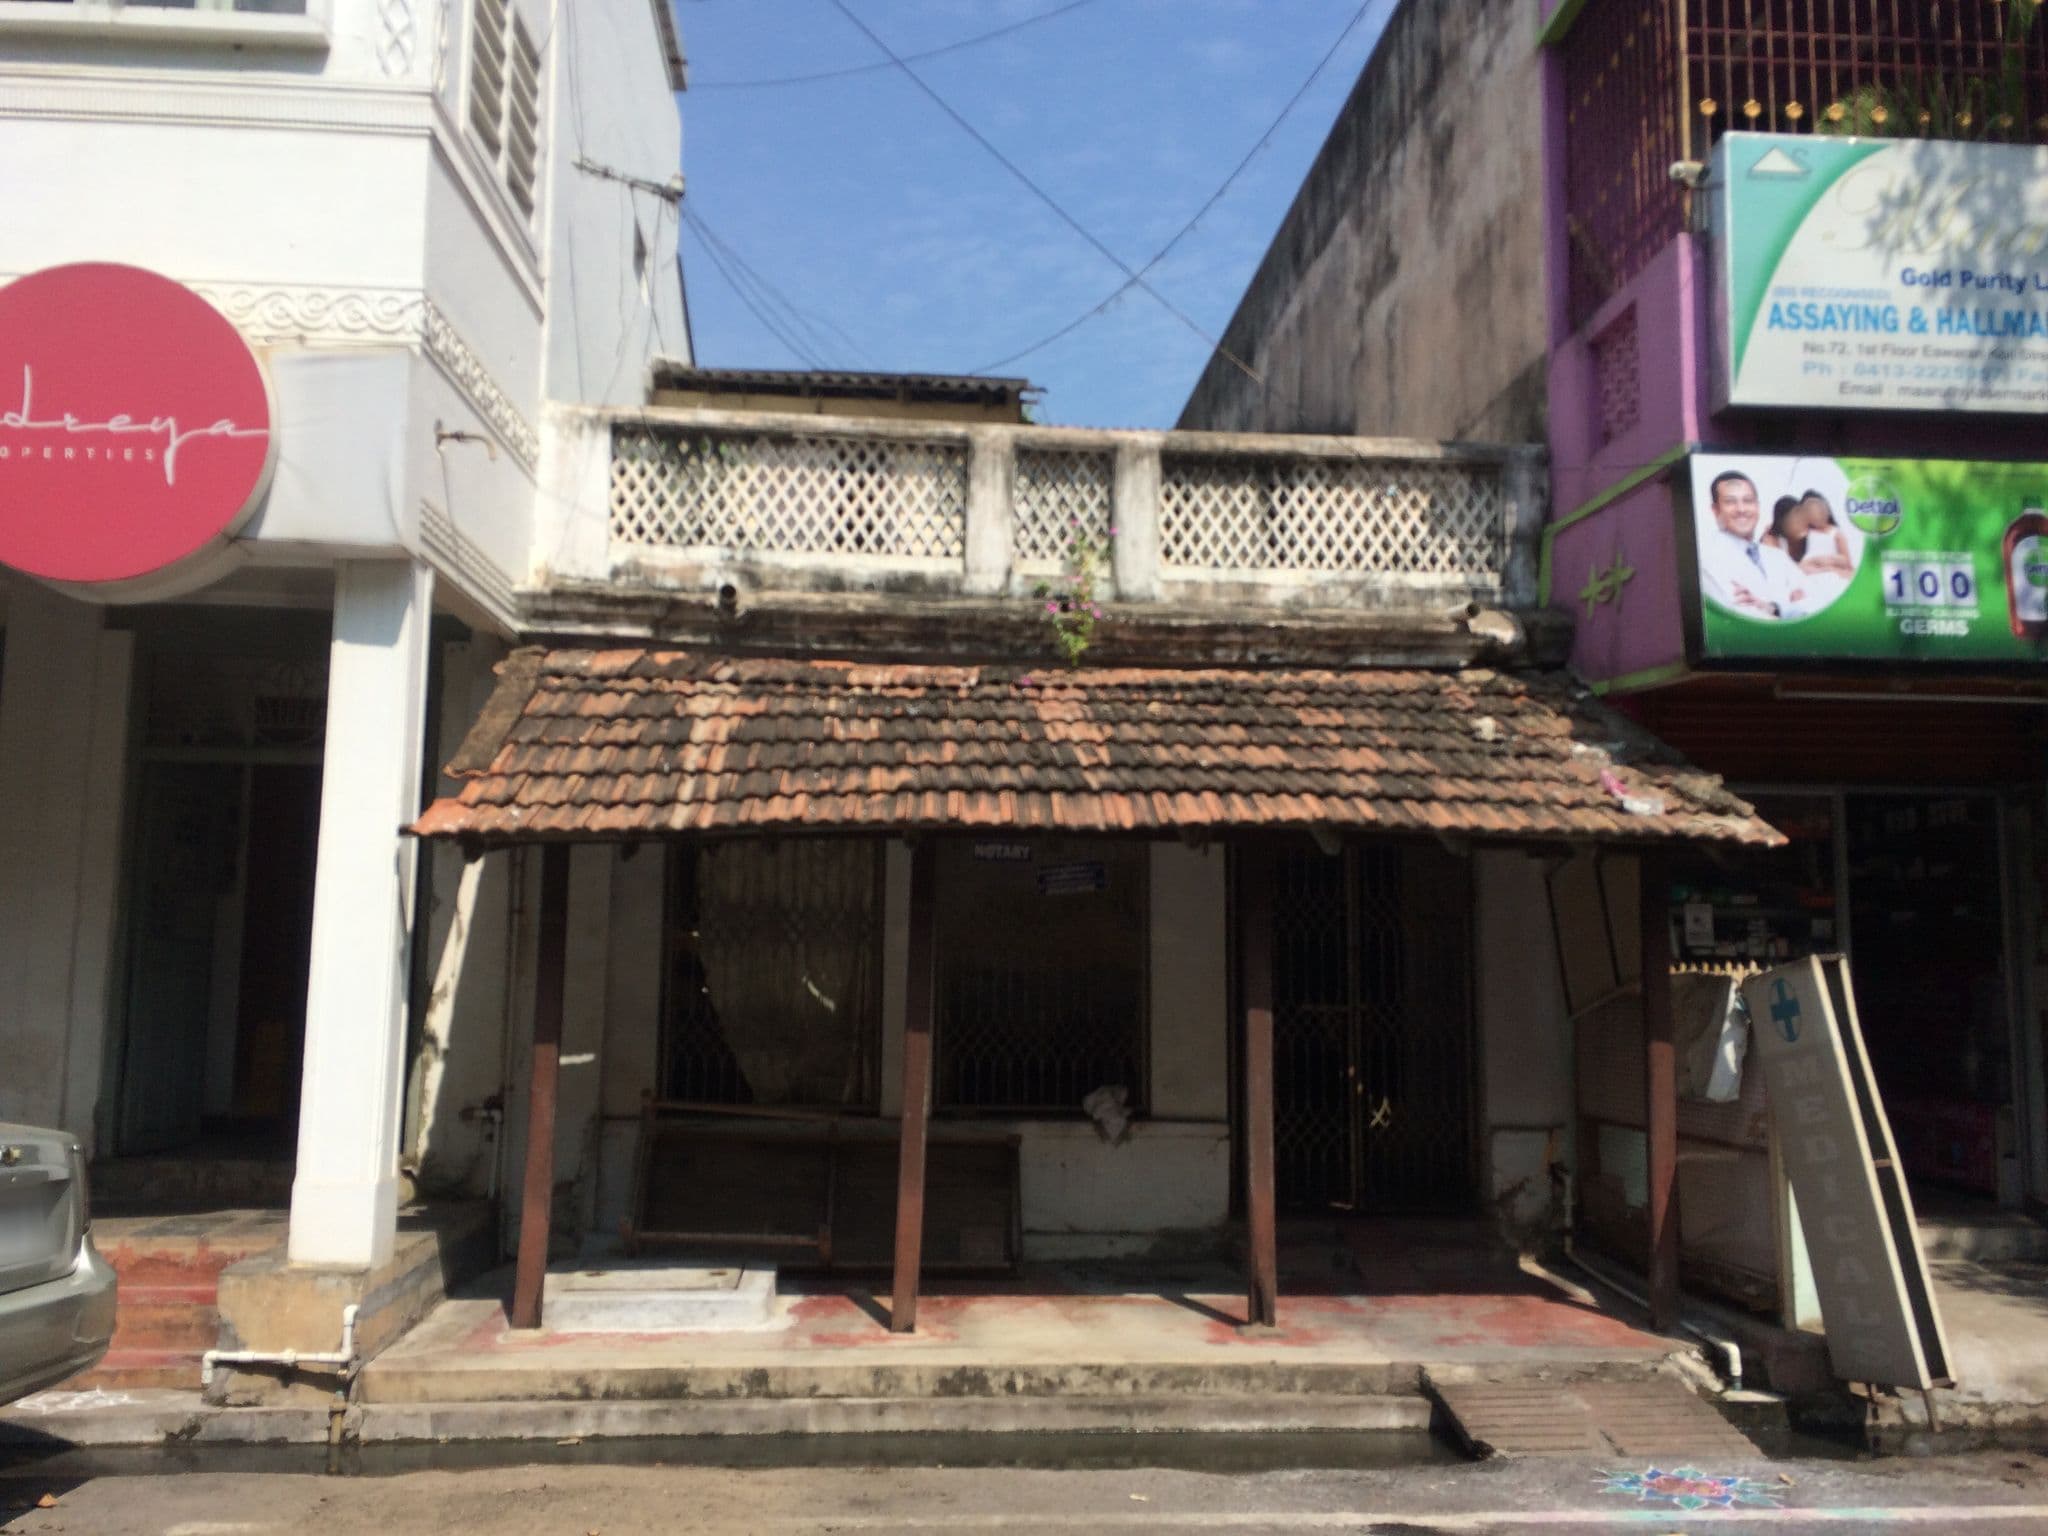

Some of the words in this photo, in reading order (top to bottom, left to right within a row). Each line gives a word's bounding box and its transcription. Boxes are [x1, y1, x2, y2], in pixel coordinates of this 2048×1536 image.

[1901, 267, 1952, 288] Gold
[1959, 269, 2027, 294] Purity
[1767, 302, 1899, 334] ASSAYING
[1908, 306, 1928, 334] &
[1936, 307, 2048, 338] HALLMA
[1900, 619, 1969, 636] GERMS
